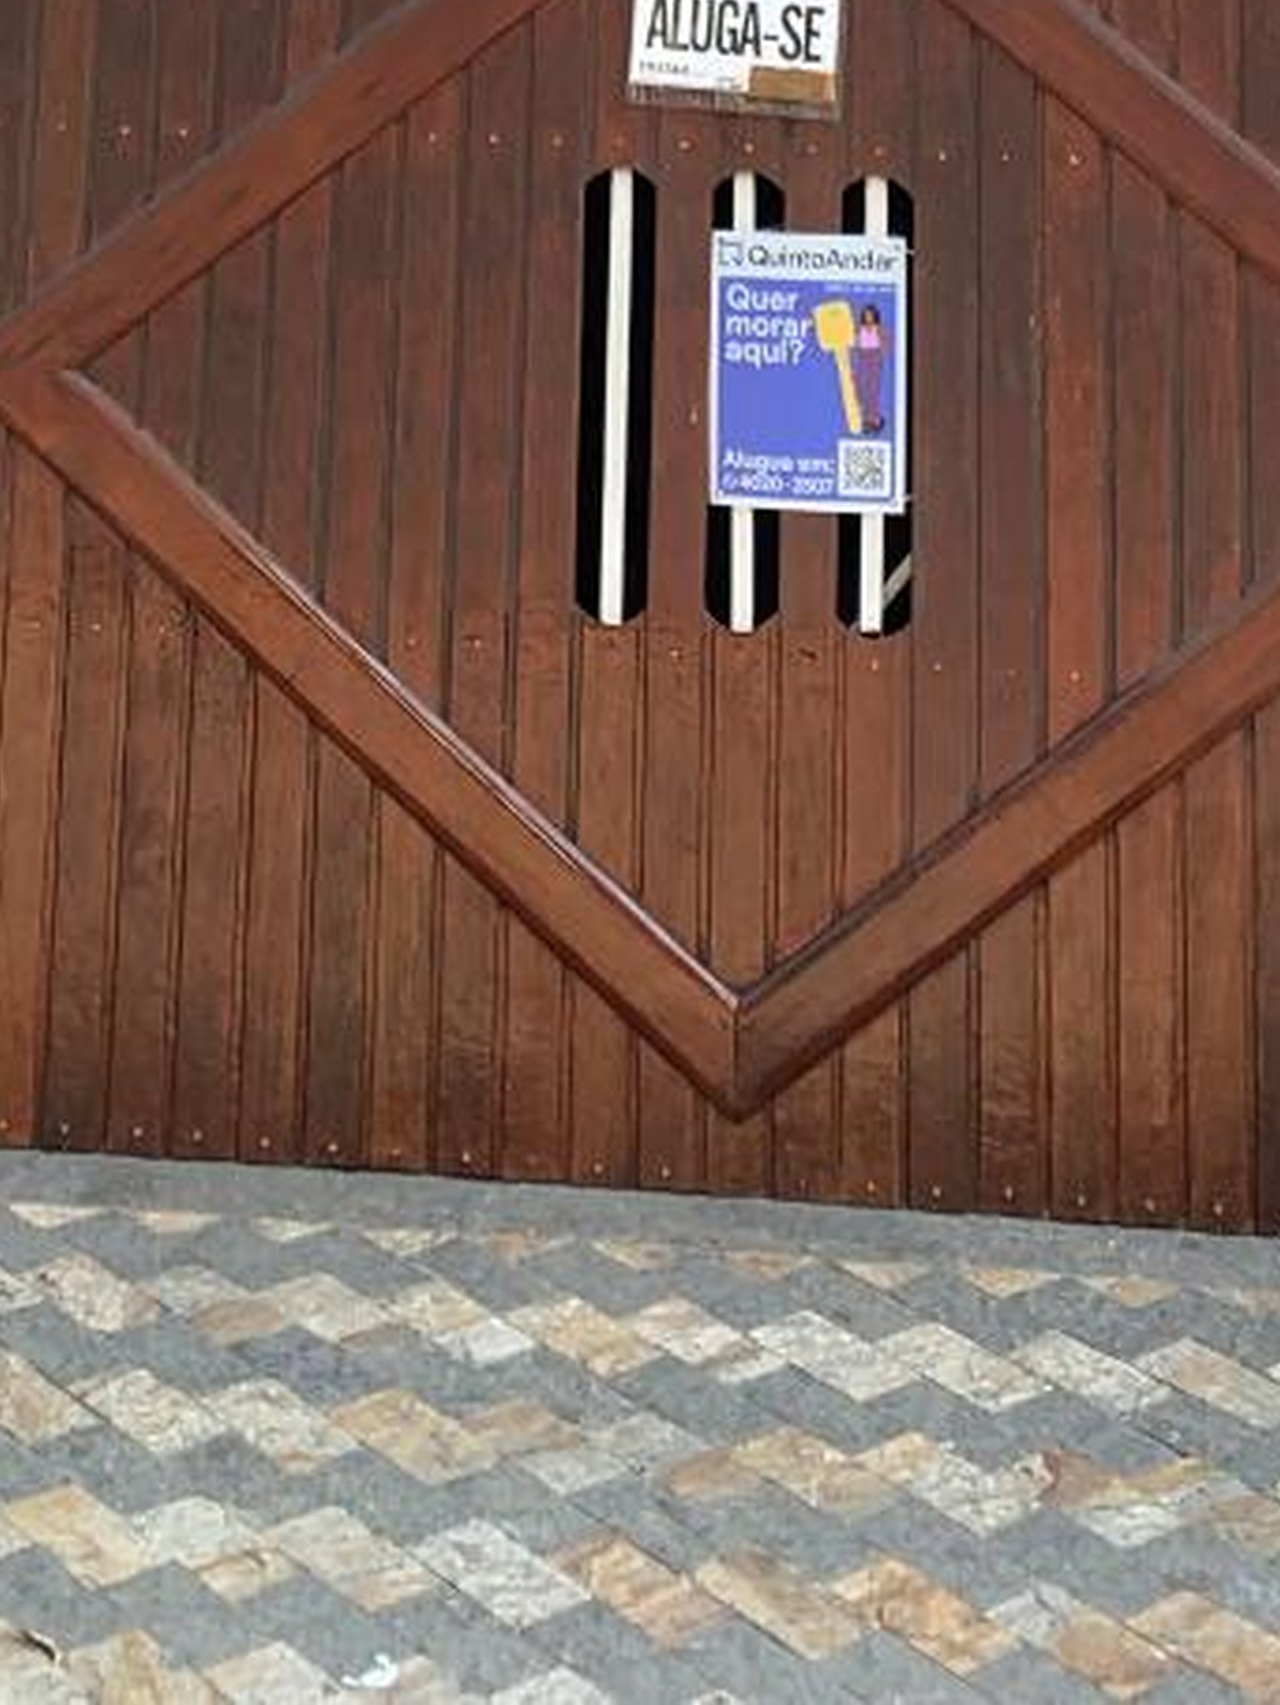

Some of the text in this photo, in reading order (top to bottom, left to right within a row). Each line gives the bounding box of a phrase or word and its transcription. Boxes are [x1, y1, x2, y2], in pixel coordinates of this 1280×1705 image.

[748, 244, 898, 271] QuintoAndar
[726, 283, 798, 311] Quer
[726, 314, 812, 337] morar
[724, 340, 804, 368] aqui?
